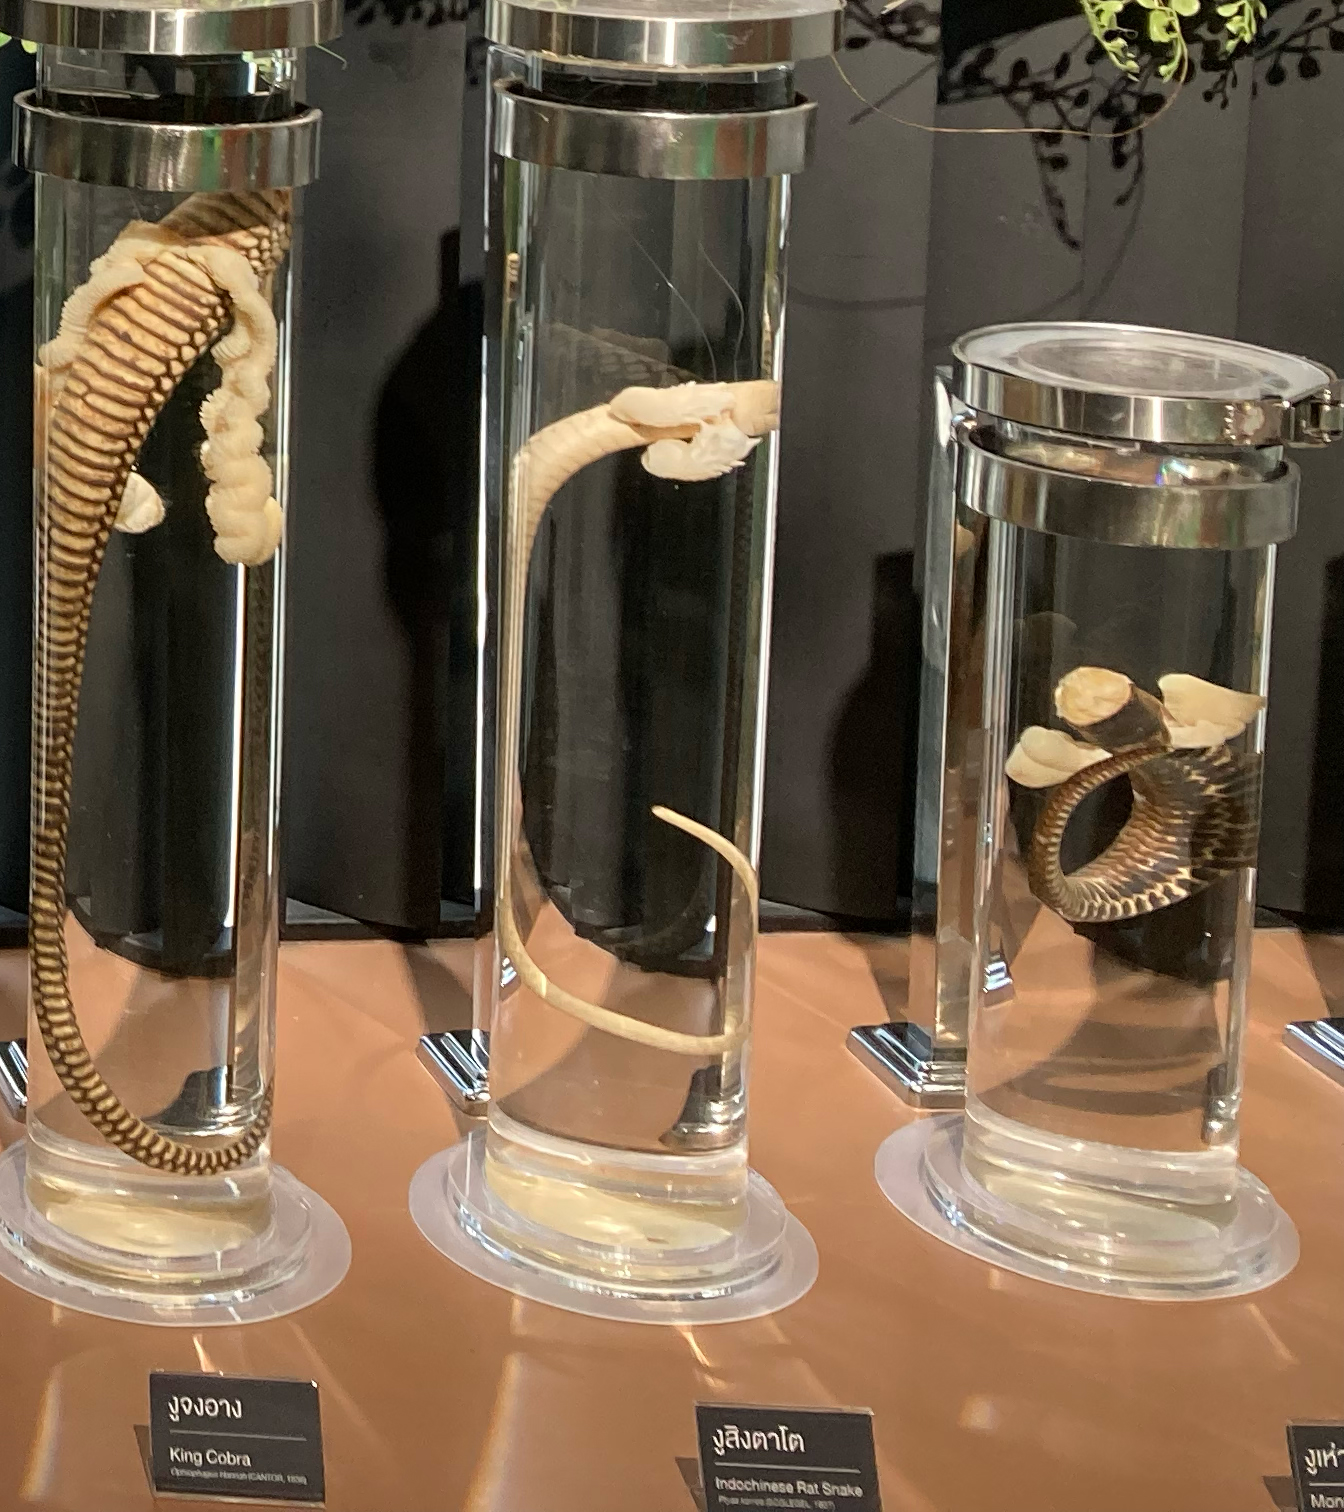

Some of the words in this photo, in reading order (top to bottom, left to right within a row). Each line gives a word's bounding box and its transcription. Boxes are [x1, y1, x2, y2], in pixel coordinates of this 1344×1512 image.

[168, 1395, 242, 1422] งูจงอาง
[712, 1424, 806, 1456] งูสิงตาโต
[169, 1446, 203, 1467] King
[206, 1448, 252, 1467] Cobra
[714, 1476, 794, 1494] Indochinese
[796, 1480, 820, 1495] Rat
[822, 1481, 863, 1498] Snake
